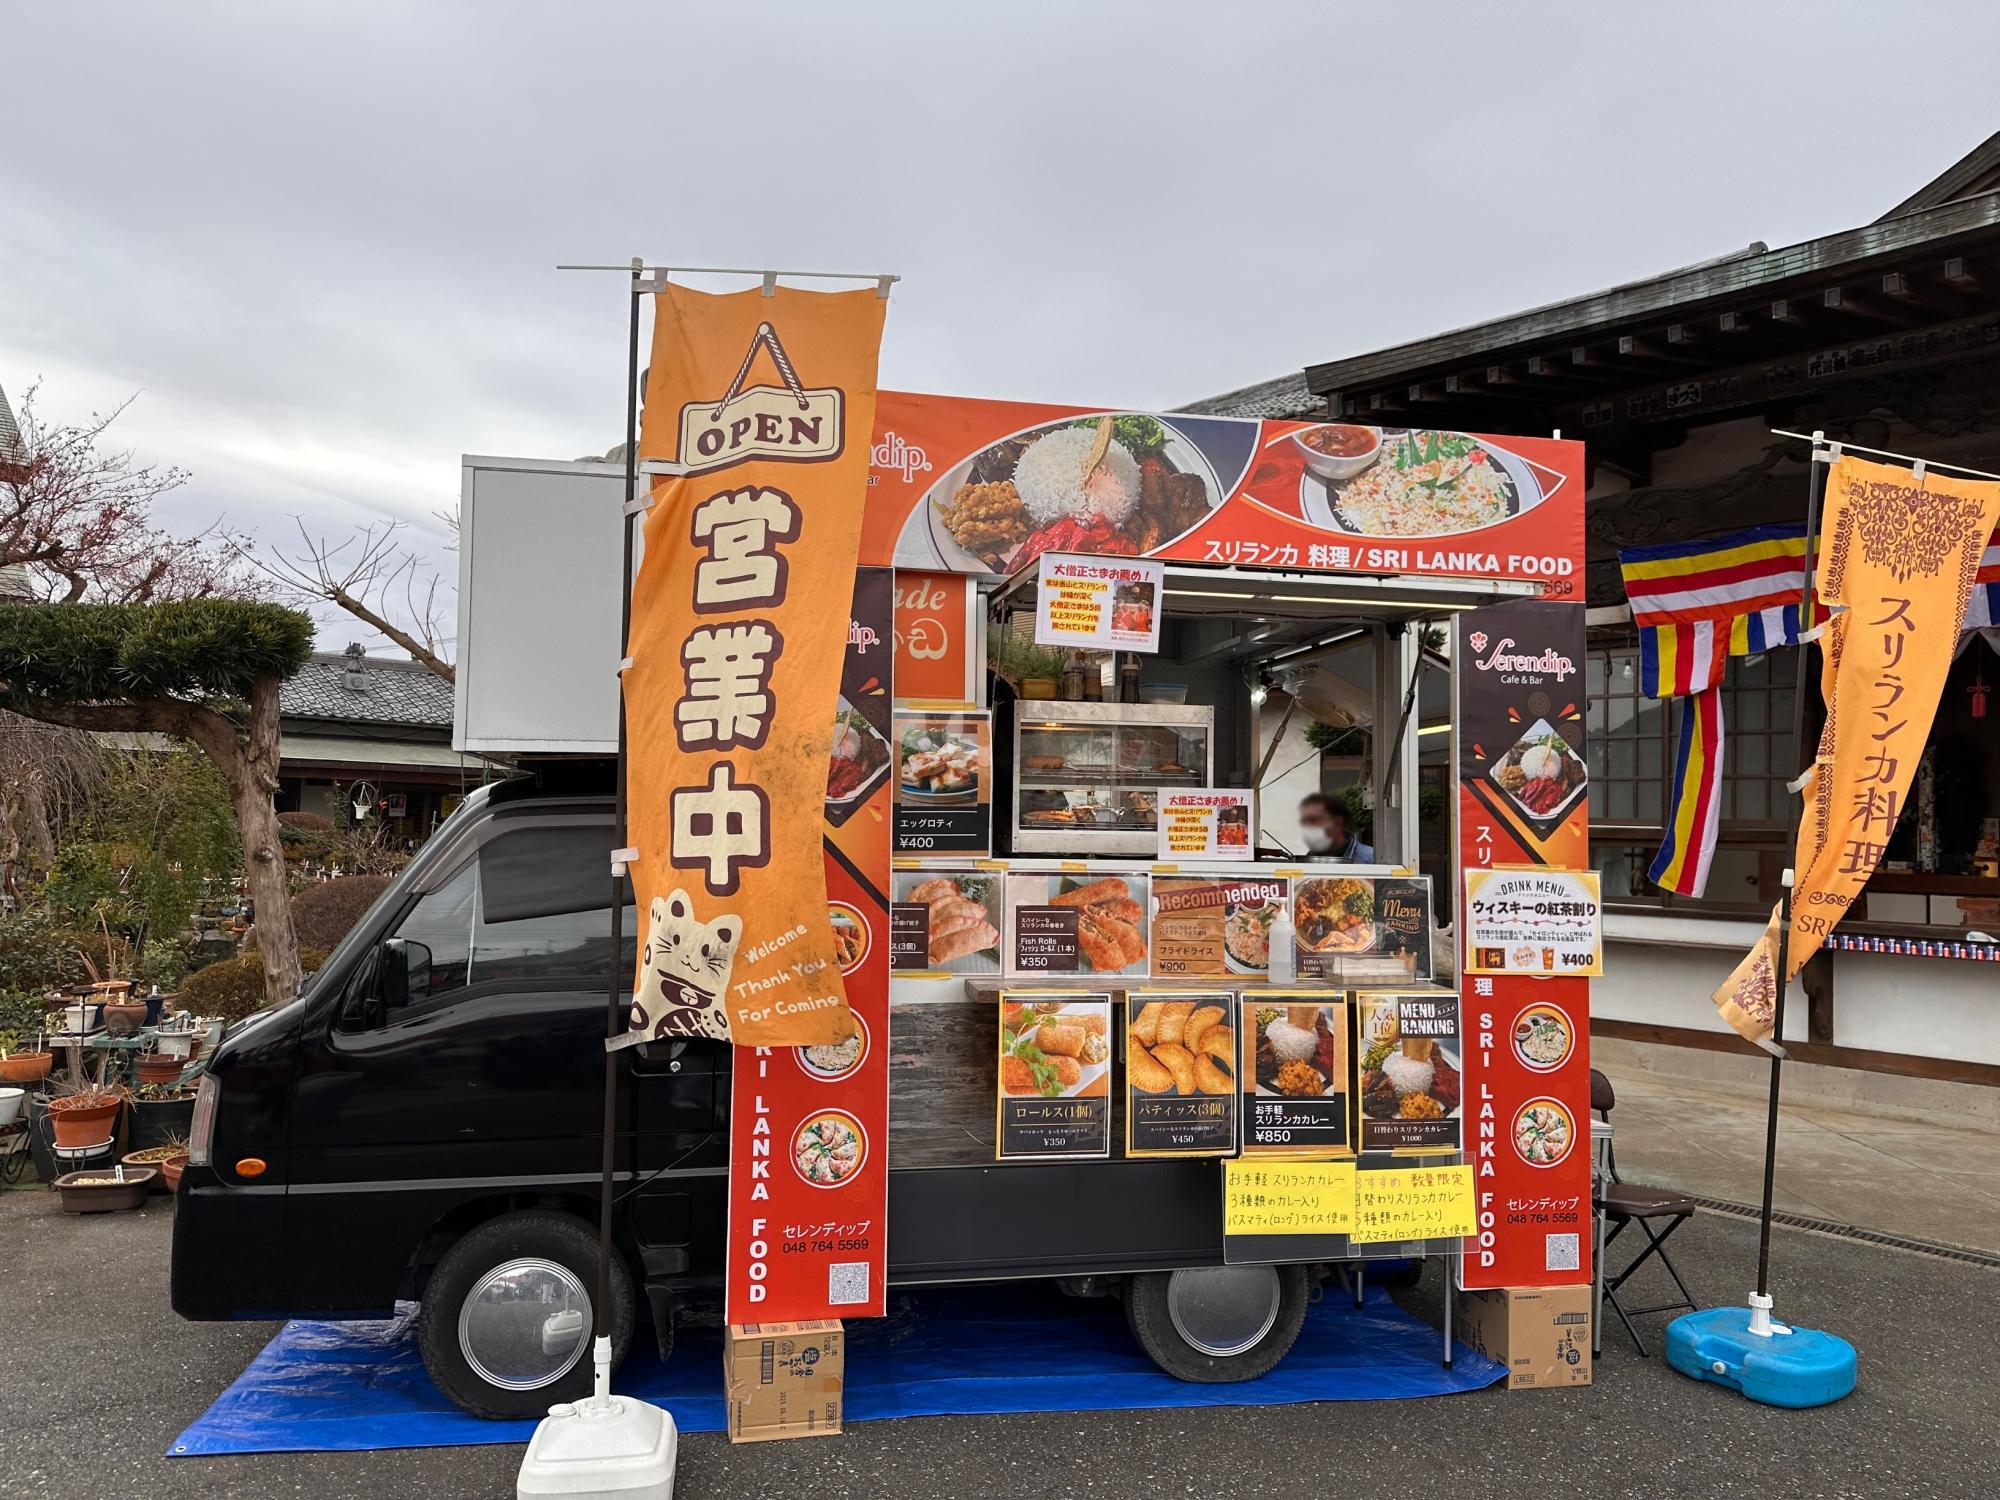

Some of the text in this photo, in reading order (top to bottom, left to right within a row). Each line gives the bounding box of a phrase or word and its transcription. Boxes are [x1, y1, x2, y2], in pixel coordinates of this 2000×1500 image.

[696, 413, 824, 456] OPEN
[1203, 540, 1298, 565] スリランカ
[1416, 552, 1500, 573] LANKA
[1508, 555, 1573, 576] FOOD
[1501, 674, 1544, 685] Cafe & Bar
[670, 486, 803, 896] 営業中
[1843, 597, 1917, 882] スリランカ料理
[900, 819, 953, 828] エッグロティ
[899, 837, 934, 848] ¥400
[1501, 880, 1565, 897] DRINK MENU
[1382, 898, 1422, 918] Menu
[1473, 900, 1596, 916] ウィスキーの紅茶割り
[744, 923, 808, 964] Welcome
[1160, 946, 1213, 955] フライドライス
[1021, 957, 1048, 967] ¥350
[1160, 962, 1186, 971] ¥900
[1562, 953, 1593, 966] ¥400
[734, 957, 827, 999] Thank You
[738, 995, 839, 1025] For Coming
[1371, 1008, 1395, 1022] 人気
[1400, 1003, 1436, 1018] MENU
[1373, 1023, 1392, 1035] 1位
[1400, 1019, 1454, 1035] RANKING
[1016, 1105, 1092, 1119] ロールス(1個)
[1139, 1103, 1225, 1117] パティッス(3個)
[1255, 1105, 1284, 1115] お手軽
[1255, 1115, 1329, 1125] スリランカカレー
[1255, 1130, 1291, 1142] ¥850
[1374, 1126, 1448, 1134] 日替わりスリランカカレー
[1043, 1137, 1066, 1146] ¥350
[1172, 1135, 1194, 1144] ¥450
[1478, 1013, 1496, 1267] SRI LANKA FOOD
[751, 1096, 770, 1200] LANKA
[1228, 1171, 1345, 1187] お手軽 スリランカカレー
[1410, 1172, 1464, 1189] 数量限定
[1230, 1193, 1320, 1209] 3種類のカレー入り
[1506, 1197, 1579, 1211] セレンディップ
[1507, 1213, 1578, 1224] 048 764 5569
[782, 1221, 870, 1238] セレンディップ
[782, 1238, 869, 1254] 048 764 5569
[749, 1219, 767, 1302] FOOD
